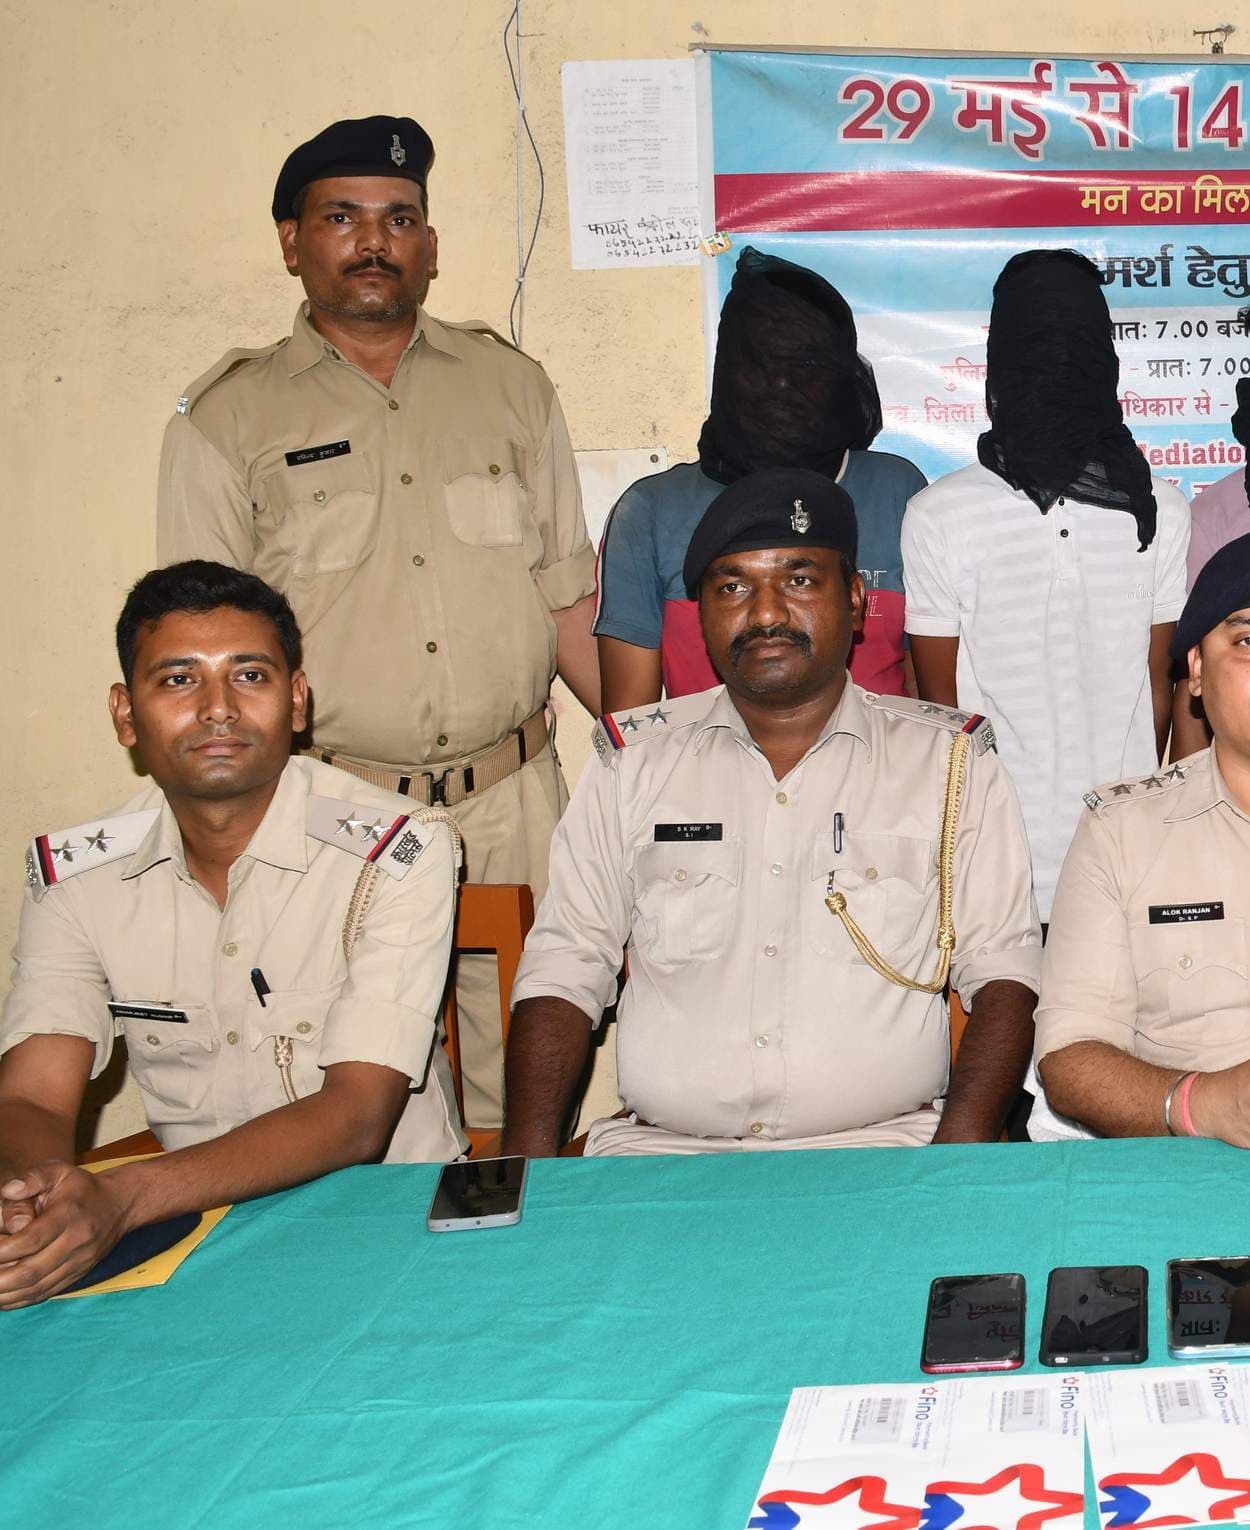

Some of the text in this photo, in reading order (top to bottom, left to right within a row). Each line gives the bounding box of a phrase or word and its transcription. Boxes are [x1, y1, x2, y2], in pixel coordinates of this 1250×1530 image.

[841, 79, 931, 140] 29
[951, 62, 1053, 158] मई
[1070, 62, 1138, 148] से
[1172, 85, 1244, 149] 14
[1080, 184, 1129, 215] मन
[1139, 183, 1183, 214] का
[1095, 243, 1174, 288] मर्श
[1156, 319, 1209, 339] 7.00
[1193, 388, 1212, 416] से
[1138, 441, 1248, 466] ediatio
[1182, 907, 1211, 915] RANJAN
[1059, 1386, 1079, 1410] Fino
[1208, 1374, 1229, 1400] Fino
[915, 1395, 937, 1421] Fino
